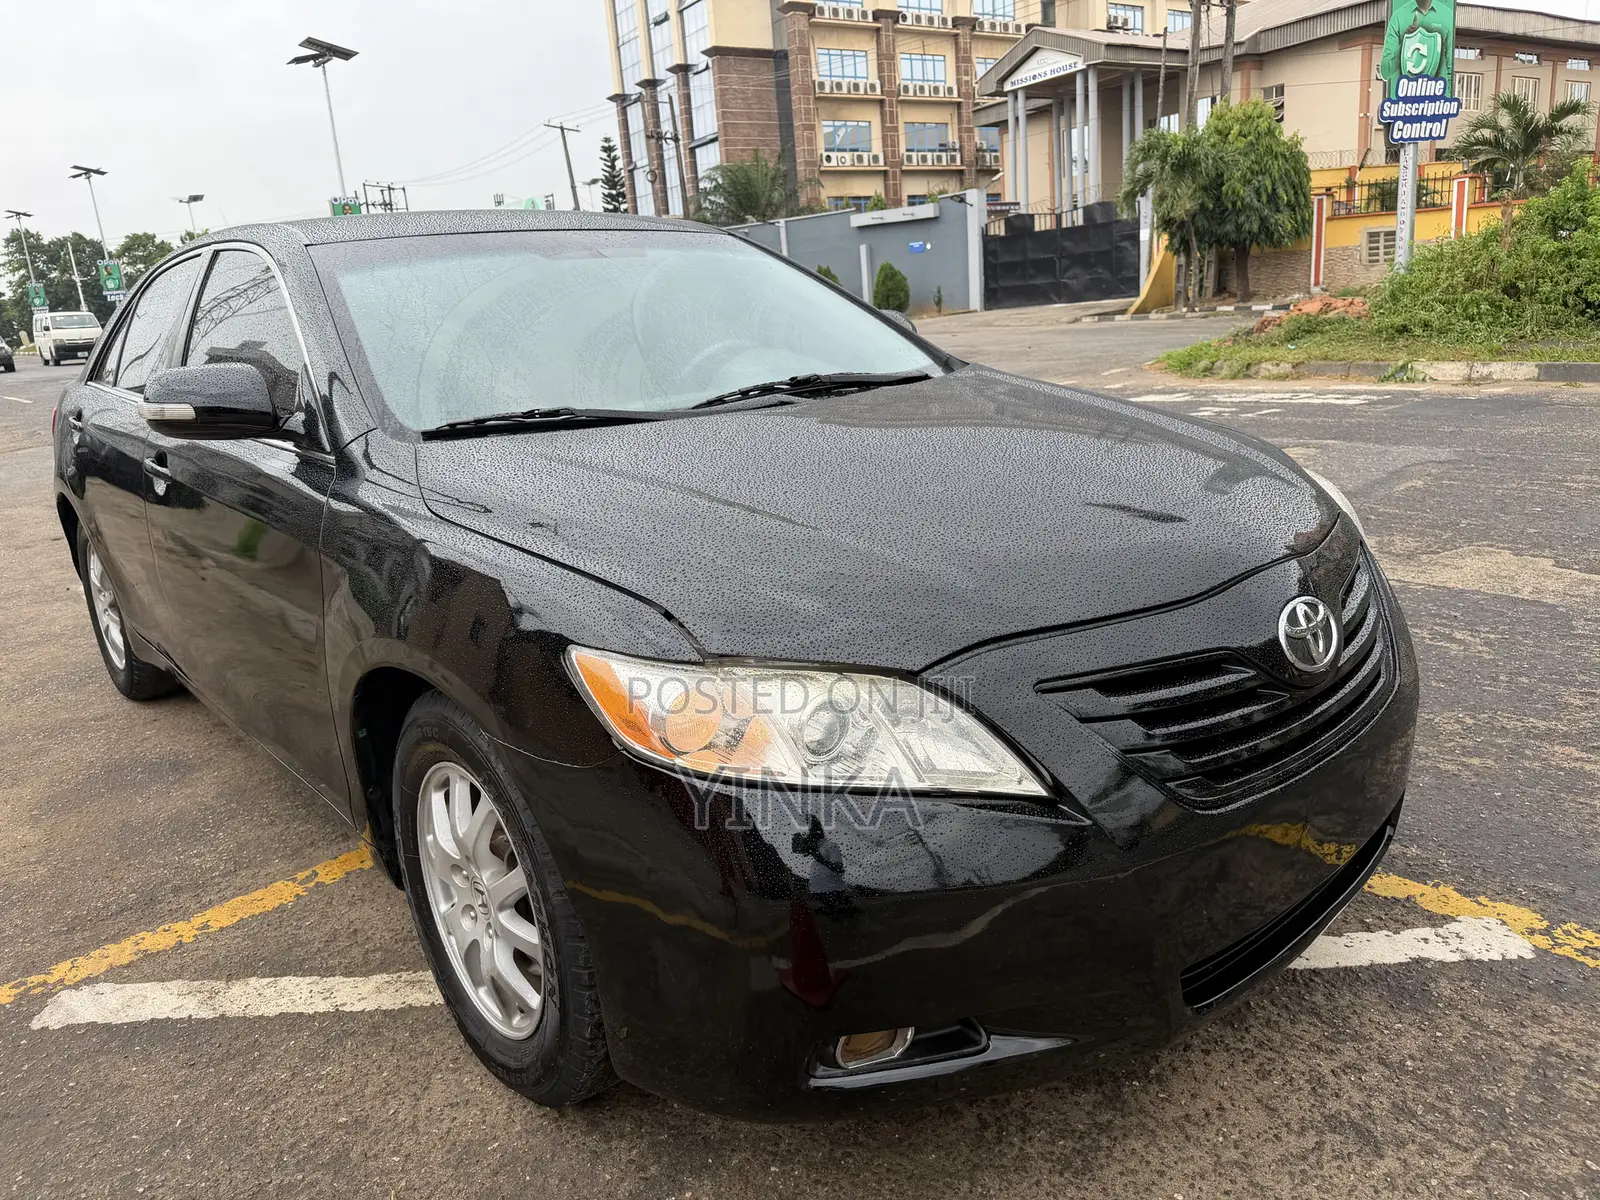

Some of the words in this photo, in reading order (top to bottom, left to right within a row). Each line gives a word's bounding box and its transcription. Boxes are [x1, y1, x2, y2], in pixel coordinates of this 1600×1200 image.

[1010, 71, 1048, 87] MISSIONS
[1049, 61, 1079, 76] HOUSE
[1397, 78, 1445, 97] Online
[1382, 100, 1458, 118] Subscription
[1392, 119, 1447, 140] Control
[331, 196, 360, 206] OPay
